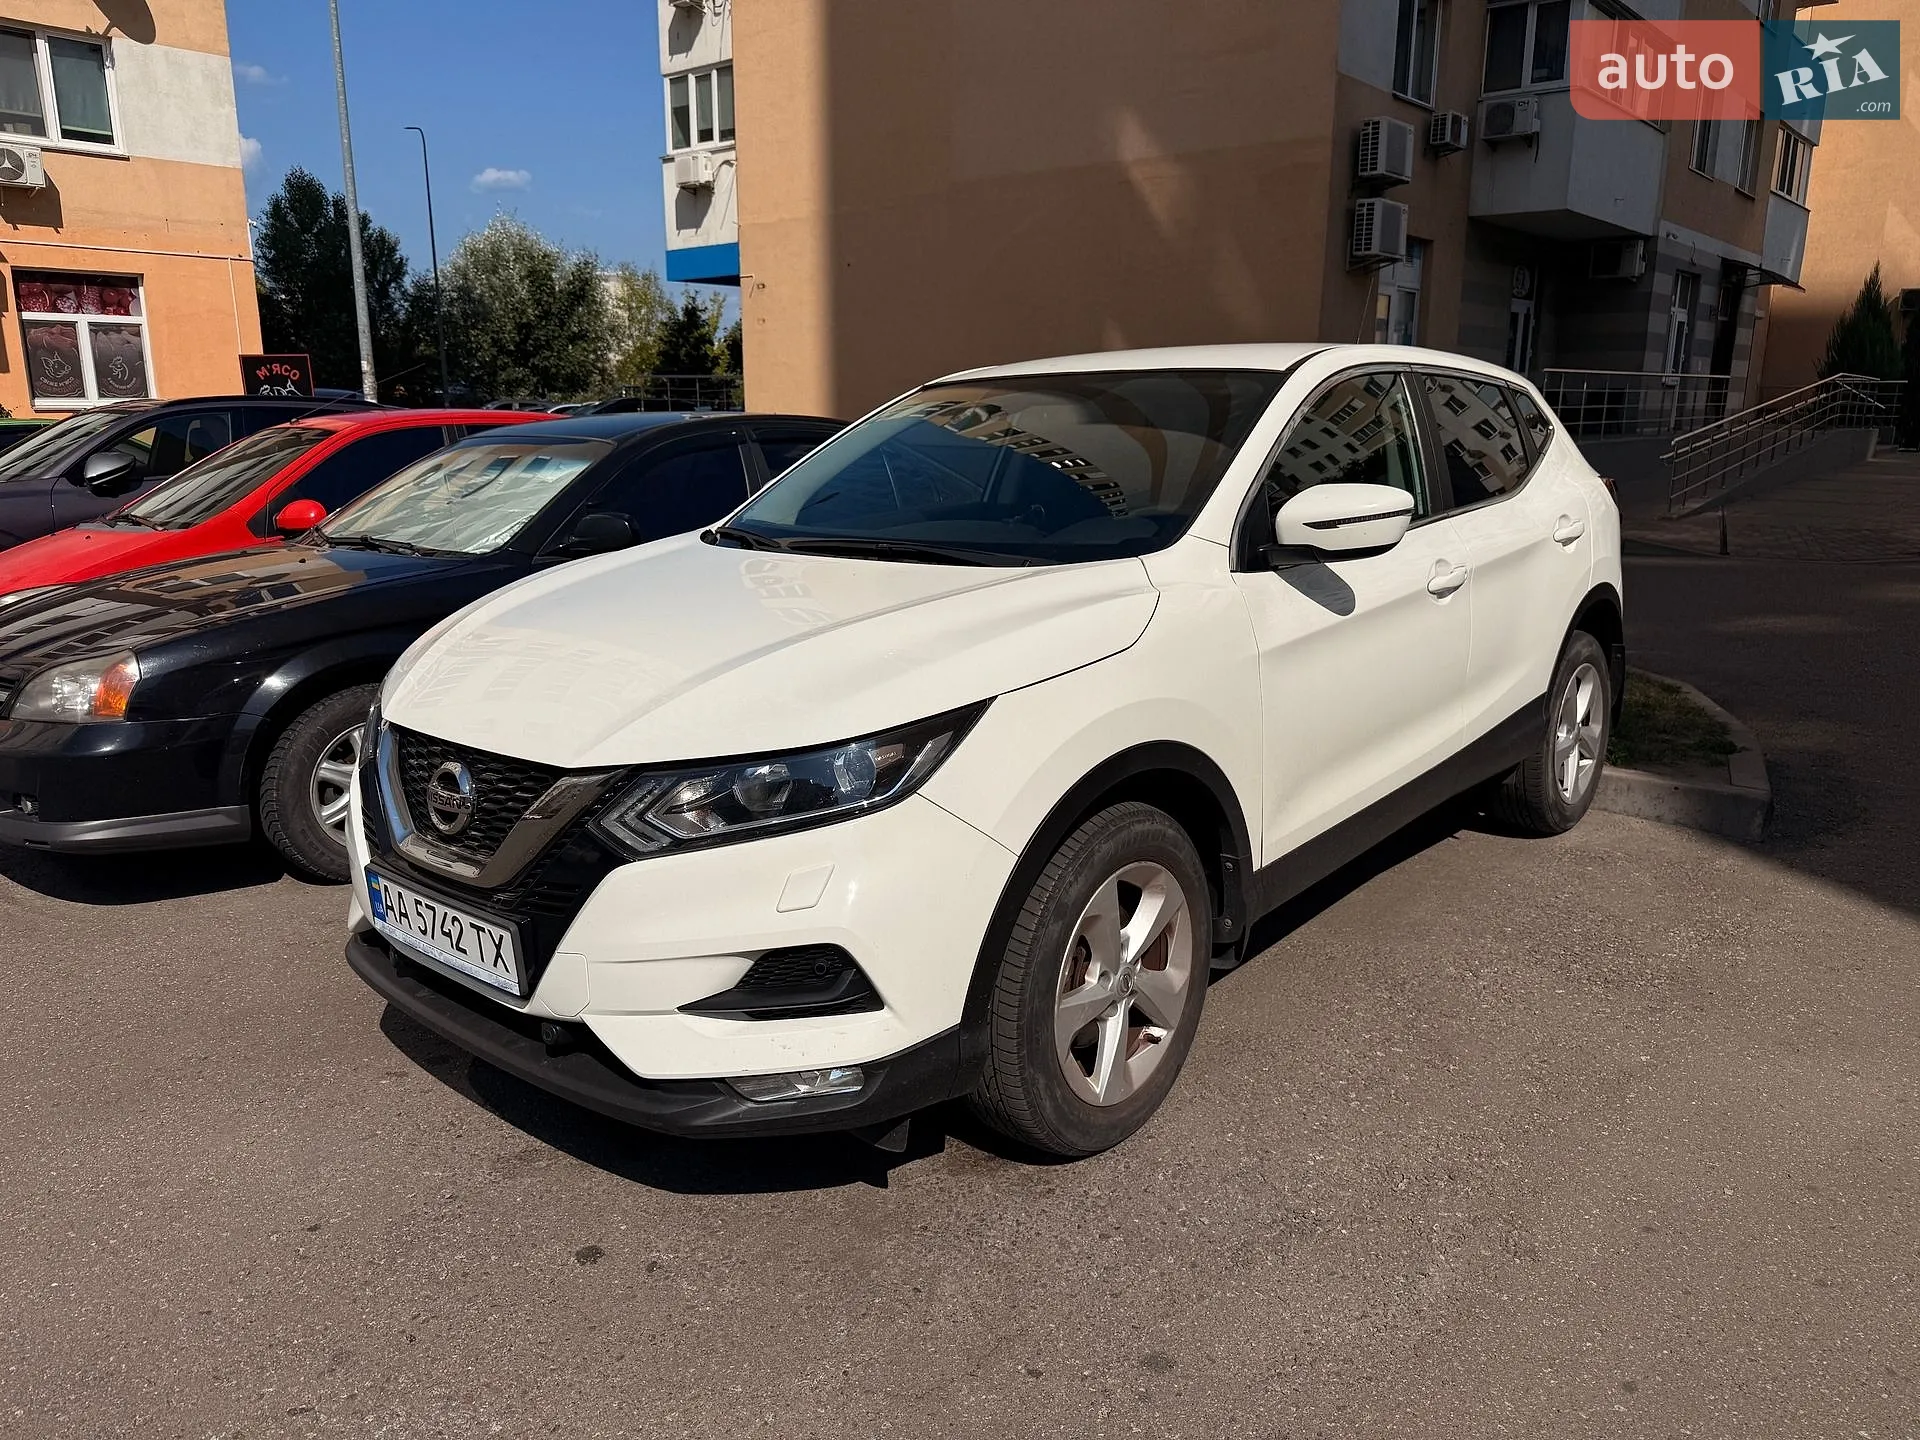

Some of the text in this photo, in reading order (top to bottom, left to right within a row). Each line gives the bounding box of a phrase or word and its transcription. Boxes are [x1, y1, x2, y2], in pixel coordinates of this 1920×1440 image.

[256, 363, 300, 380] М'ЯСО
[383, 883, 511, 974] AA 5742 TX
